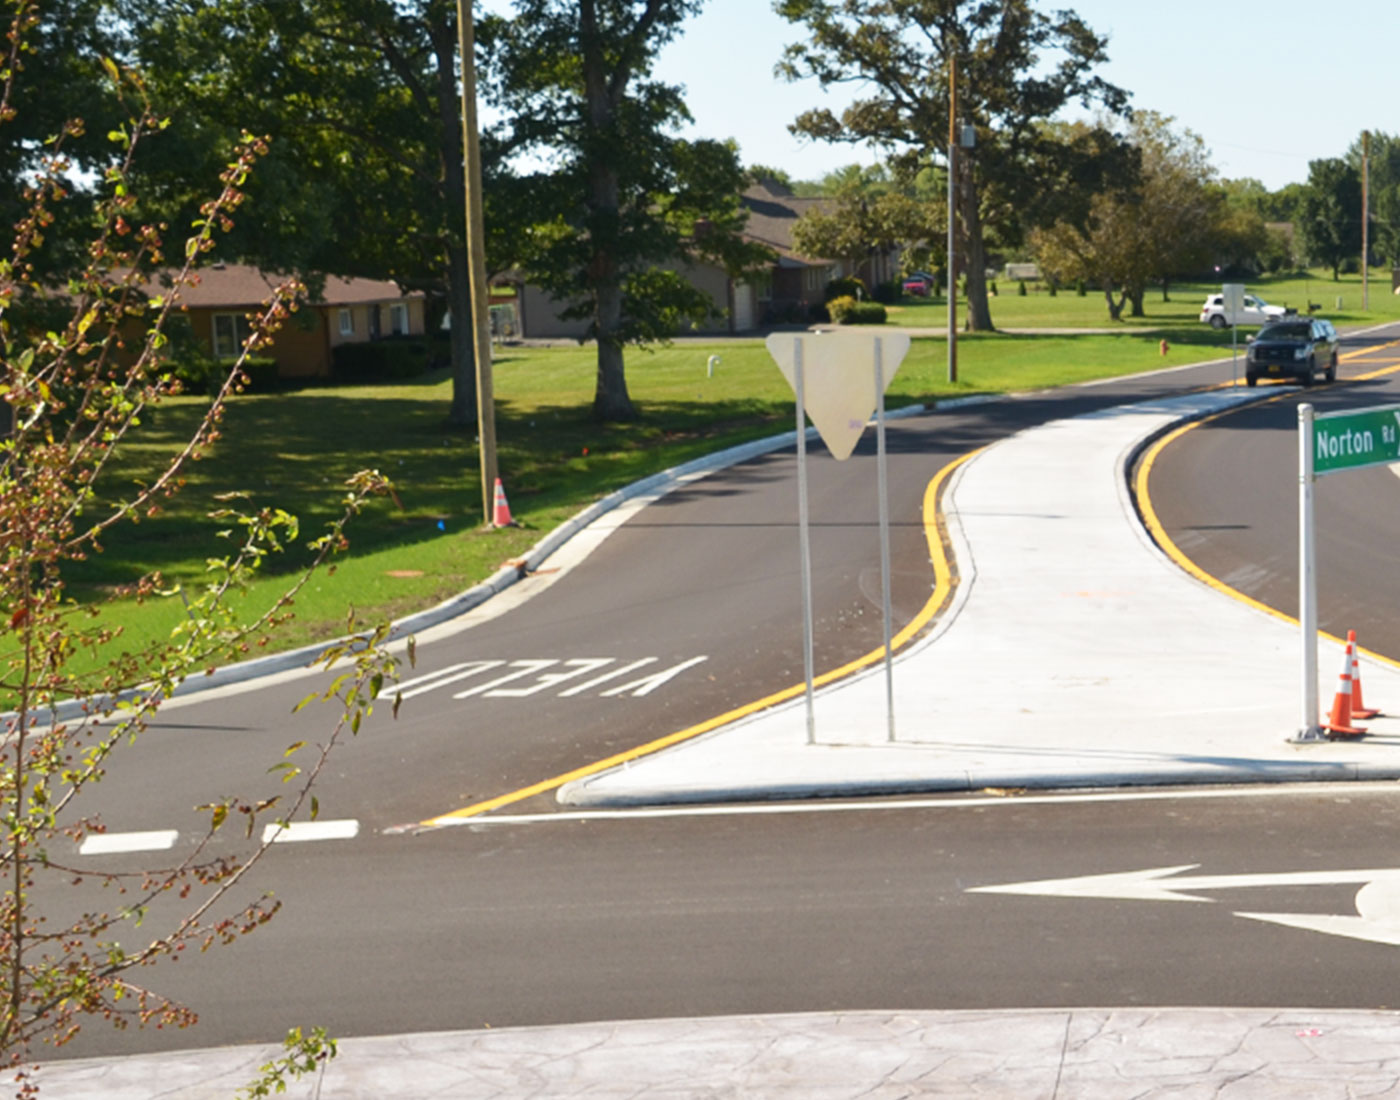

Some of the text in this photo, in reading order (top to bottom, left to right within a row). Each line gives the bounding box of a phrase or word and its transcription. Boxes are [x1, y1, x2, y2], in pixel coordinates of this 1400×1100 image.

[1317, 425, 1395, 459] Norton Rd
[376, 655, 709, 700] YIELD
